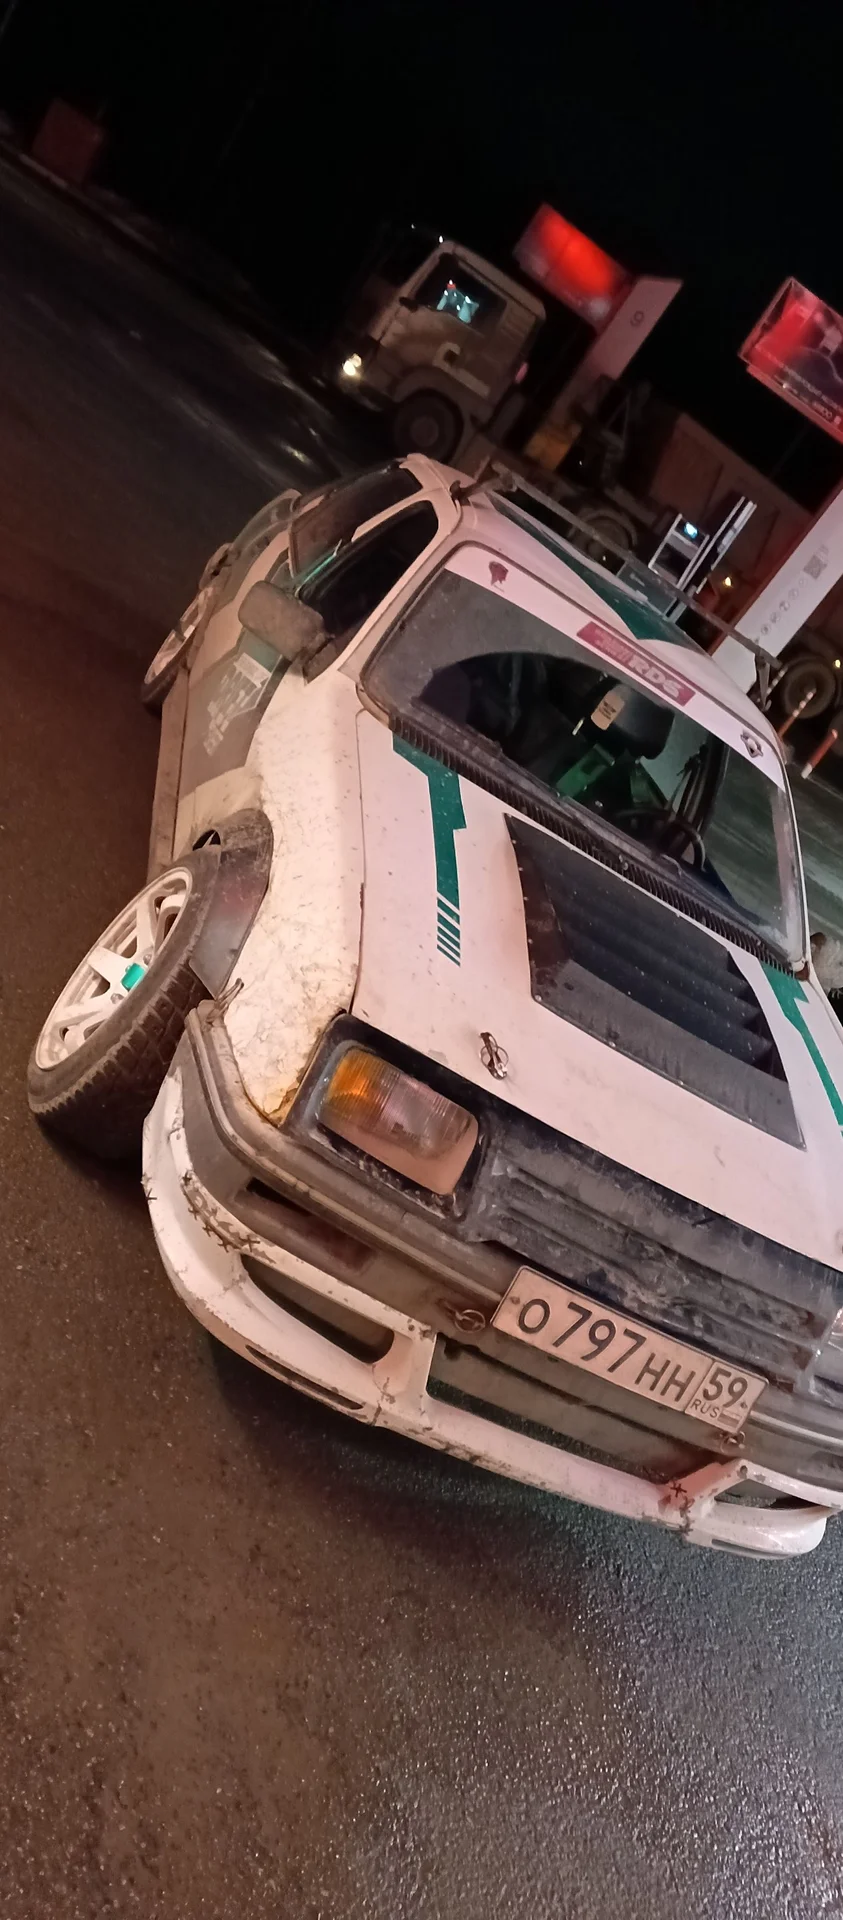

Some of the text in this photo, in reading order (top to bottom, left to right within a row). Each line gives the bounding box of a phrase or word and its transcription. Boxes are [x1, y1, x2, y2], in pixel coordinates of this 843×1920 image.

[628, 655, 684, 698] RDS
[702, 1366, 749, 1408] 59
[691, 1398, 720, 1419] RUS
